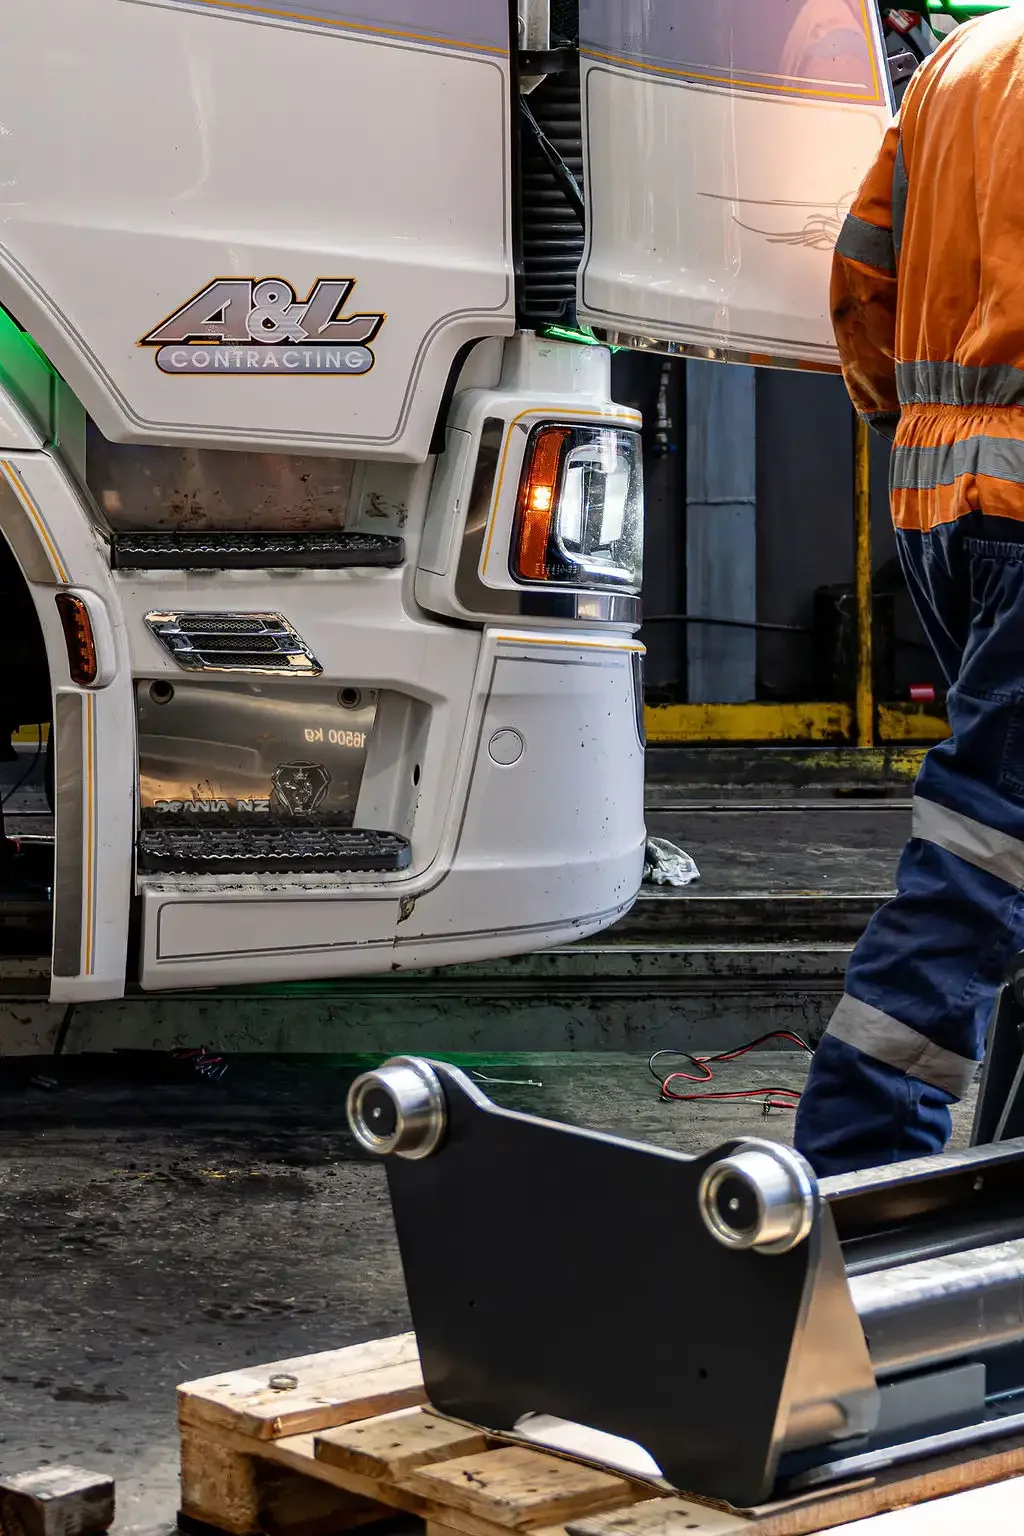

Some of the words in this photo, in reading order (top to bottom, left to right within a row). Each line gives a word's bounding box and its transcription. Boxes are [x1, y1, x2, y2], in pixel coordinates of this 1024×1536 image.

[138, 277, 387, 345] A&L
[170, 350, 365, 369] CONTRACTING
[236, 799, 271, 813] NZ
